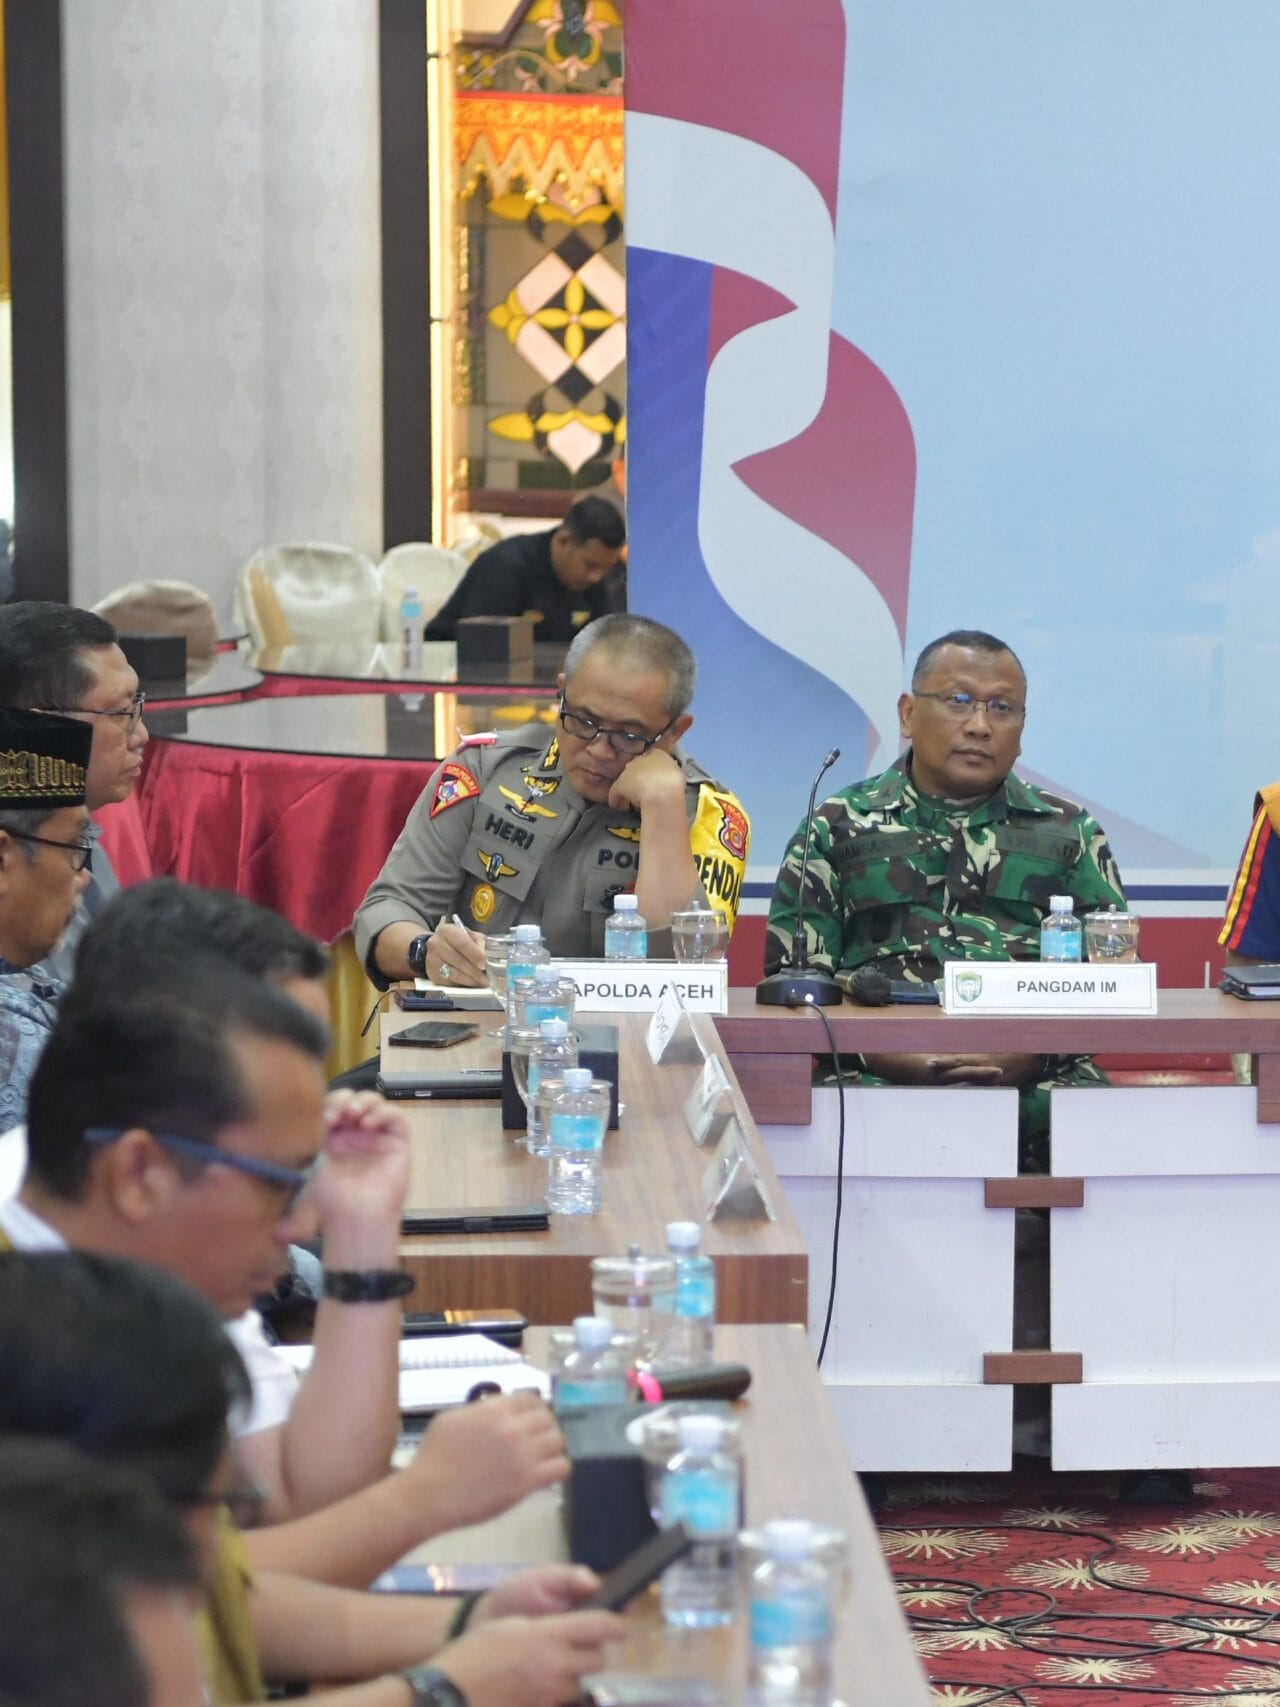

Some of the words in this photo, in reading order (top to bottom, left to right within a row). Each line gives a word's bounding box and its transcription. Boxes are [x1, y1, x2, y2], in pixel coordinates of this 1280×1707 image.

[484, 812, 535, 850] HERI
[574, 983, 652, 998] APOLDA
[1017, 980, 1096, 993] PANGDAM
[1100, 981, 1117, 993] IM
